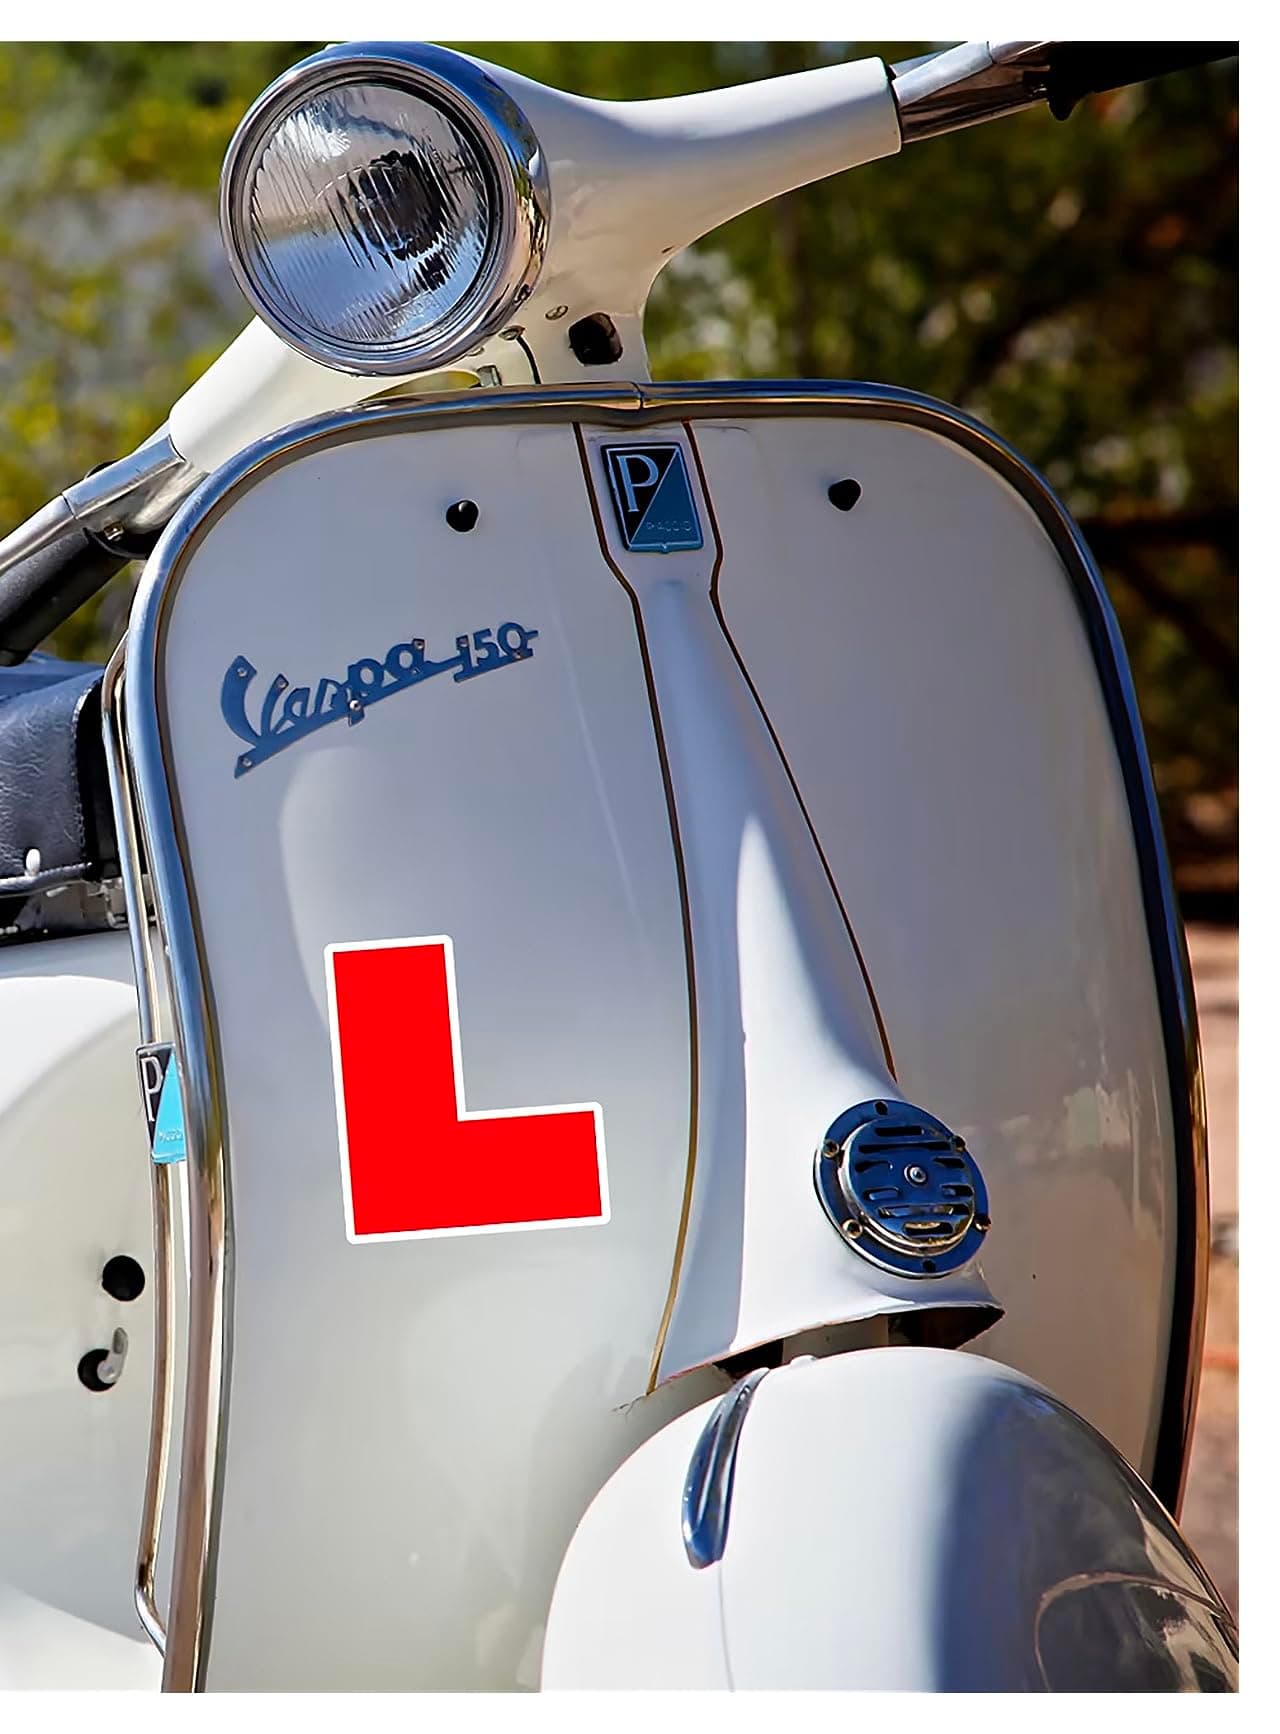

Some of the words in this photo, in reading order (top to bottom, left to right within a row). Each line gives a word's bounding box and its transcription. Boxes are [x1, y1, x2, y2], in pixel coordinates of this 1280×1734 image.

[616, 454, 659, 512] P
[221, 638, 436, 779] Vespa
[453, 622, 539, 683] 150
[140, 1055, 164, 1122] P
[332, 943, 603, 1236] L
